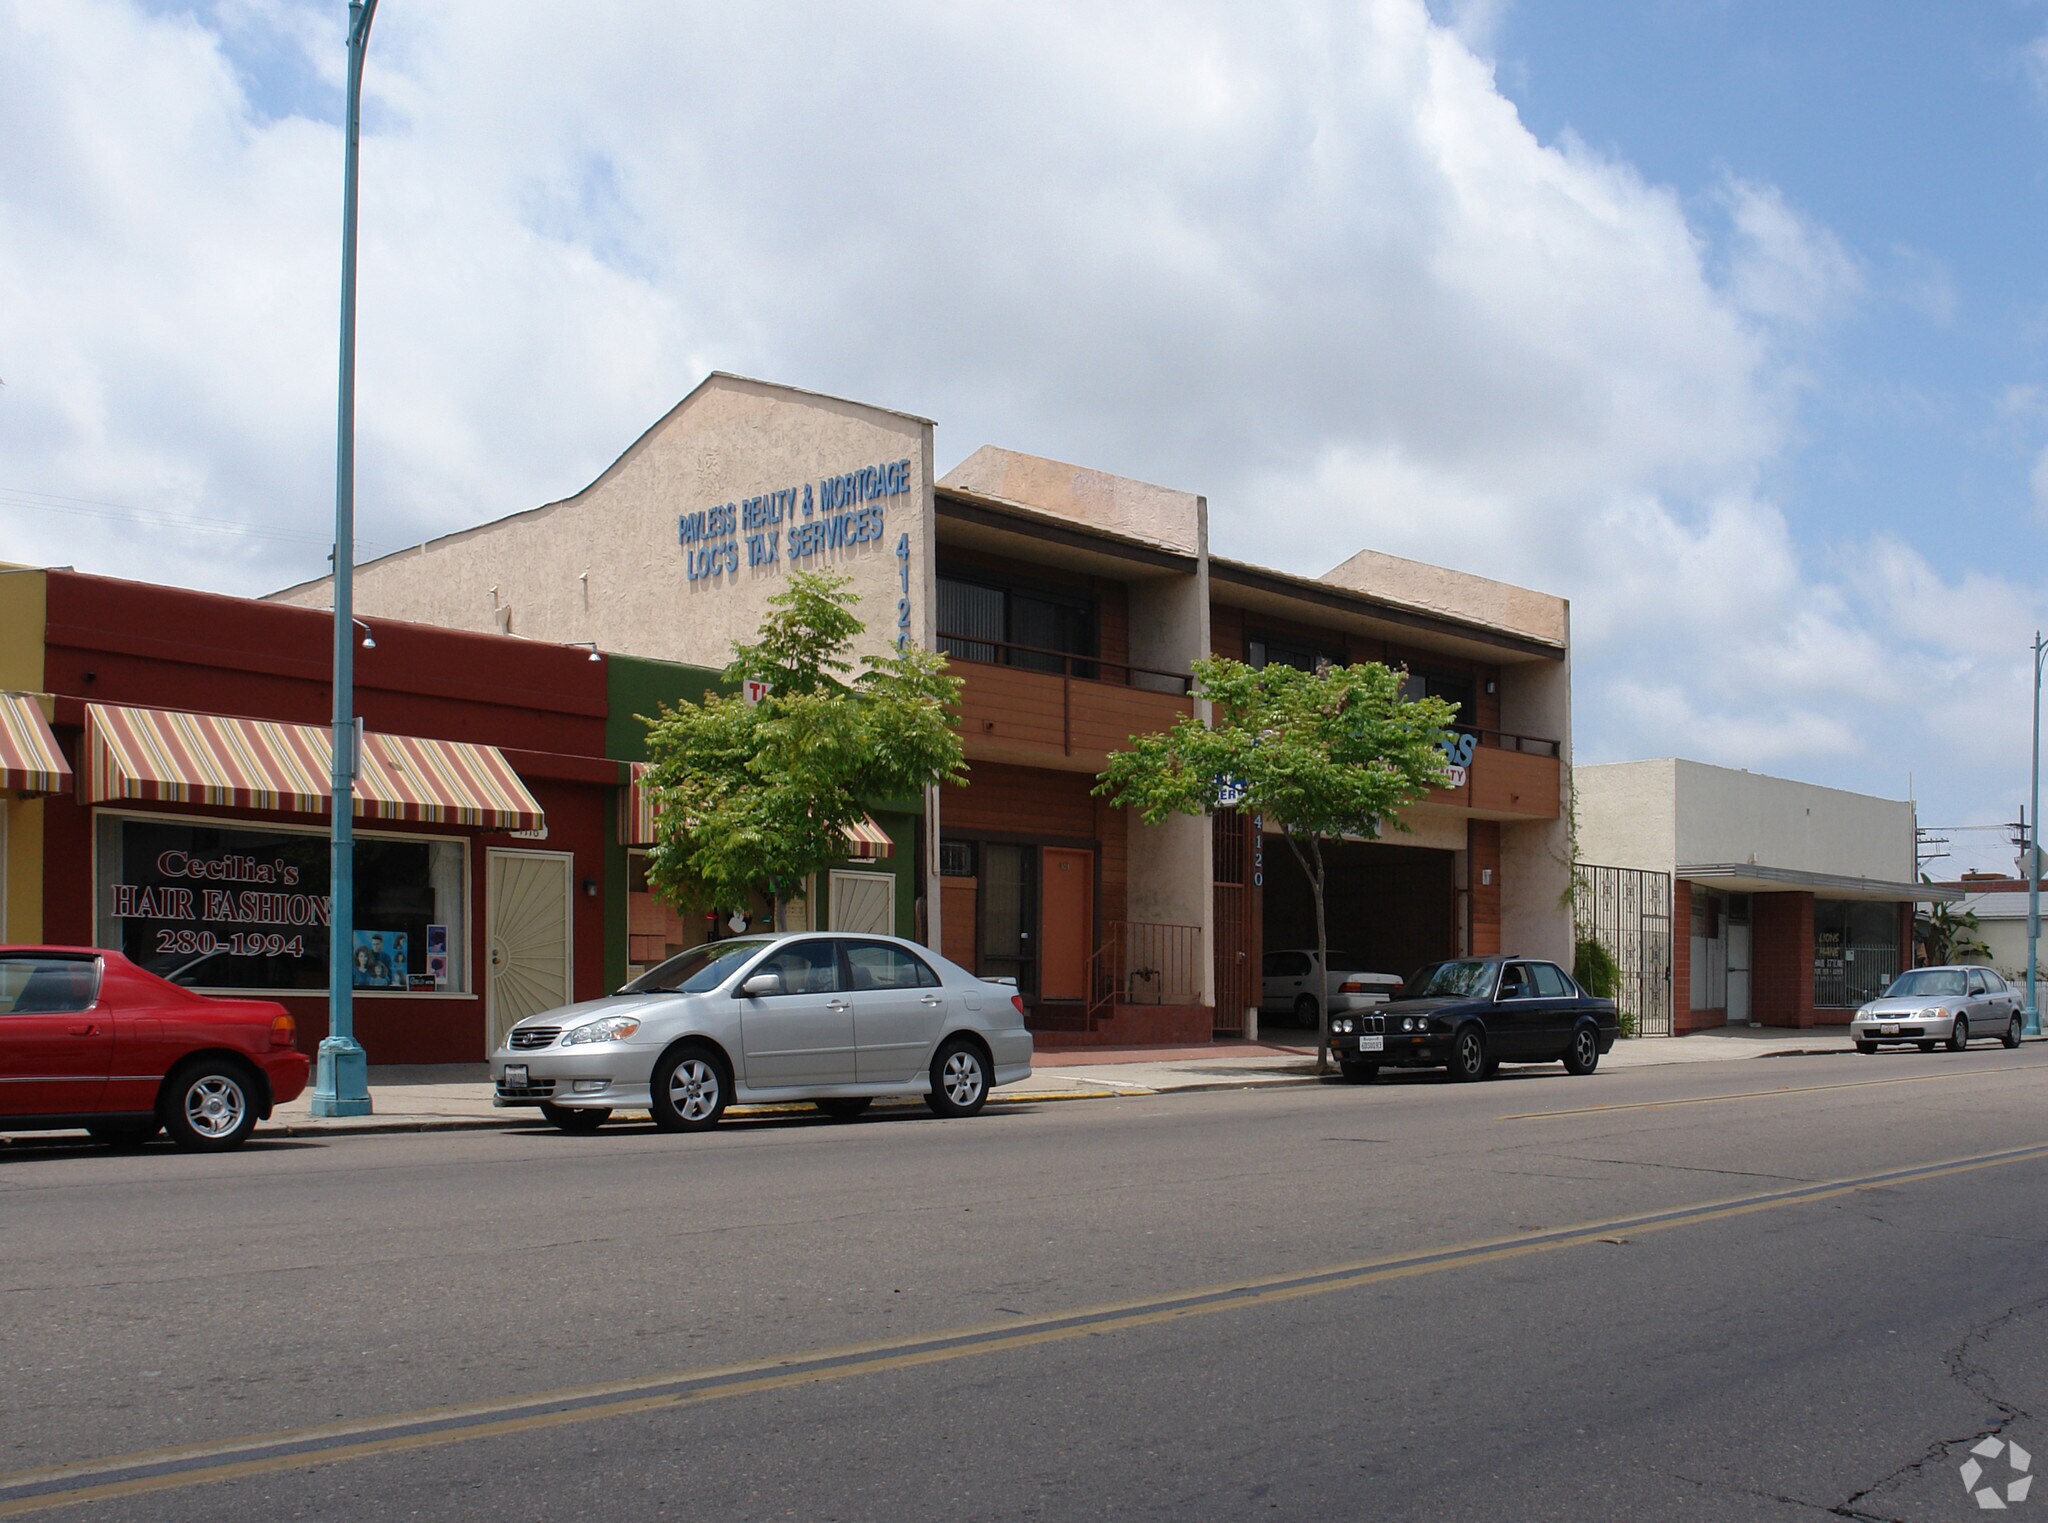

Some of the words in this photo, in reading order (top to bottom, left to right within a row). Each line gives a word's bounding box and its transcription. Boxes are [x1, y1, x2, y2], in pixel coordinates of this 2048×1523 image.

[678, 502, 737, 545] PAYLESS
[741, 487, 797, 531] REALTY
[802, 483, 813, 516] &
[820, 458, 910, 512] MORTGAGE
[687, 539, 739, 580] LOC'S
[745, 530, 780, 567] TAX
[787, 504, 883, 560] SERVICES
[157, 850, 299, 885] Cecilia's
[1253, 814, 1263, 887] 4120
[111, 884, 196, 920] HAIR
[202, 889, 331, 927] FASHION
[156, 929, 304, 957] 280-1994
